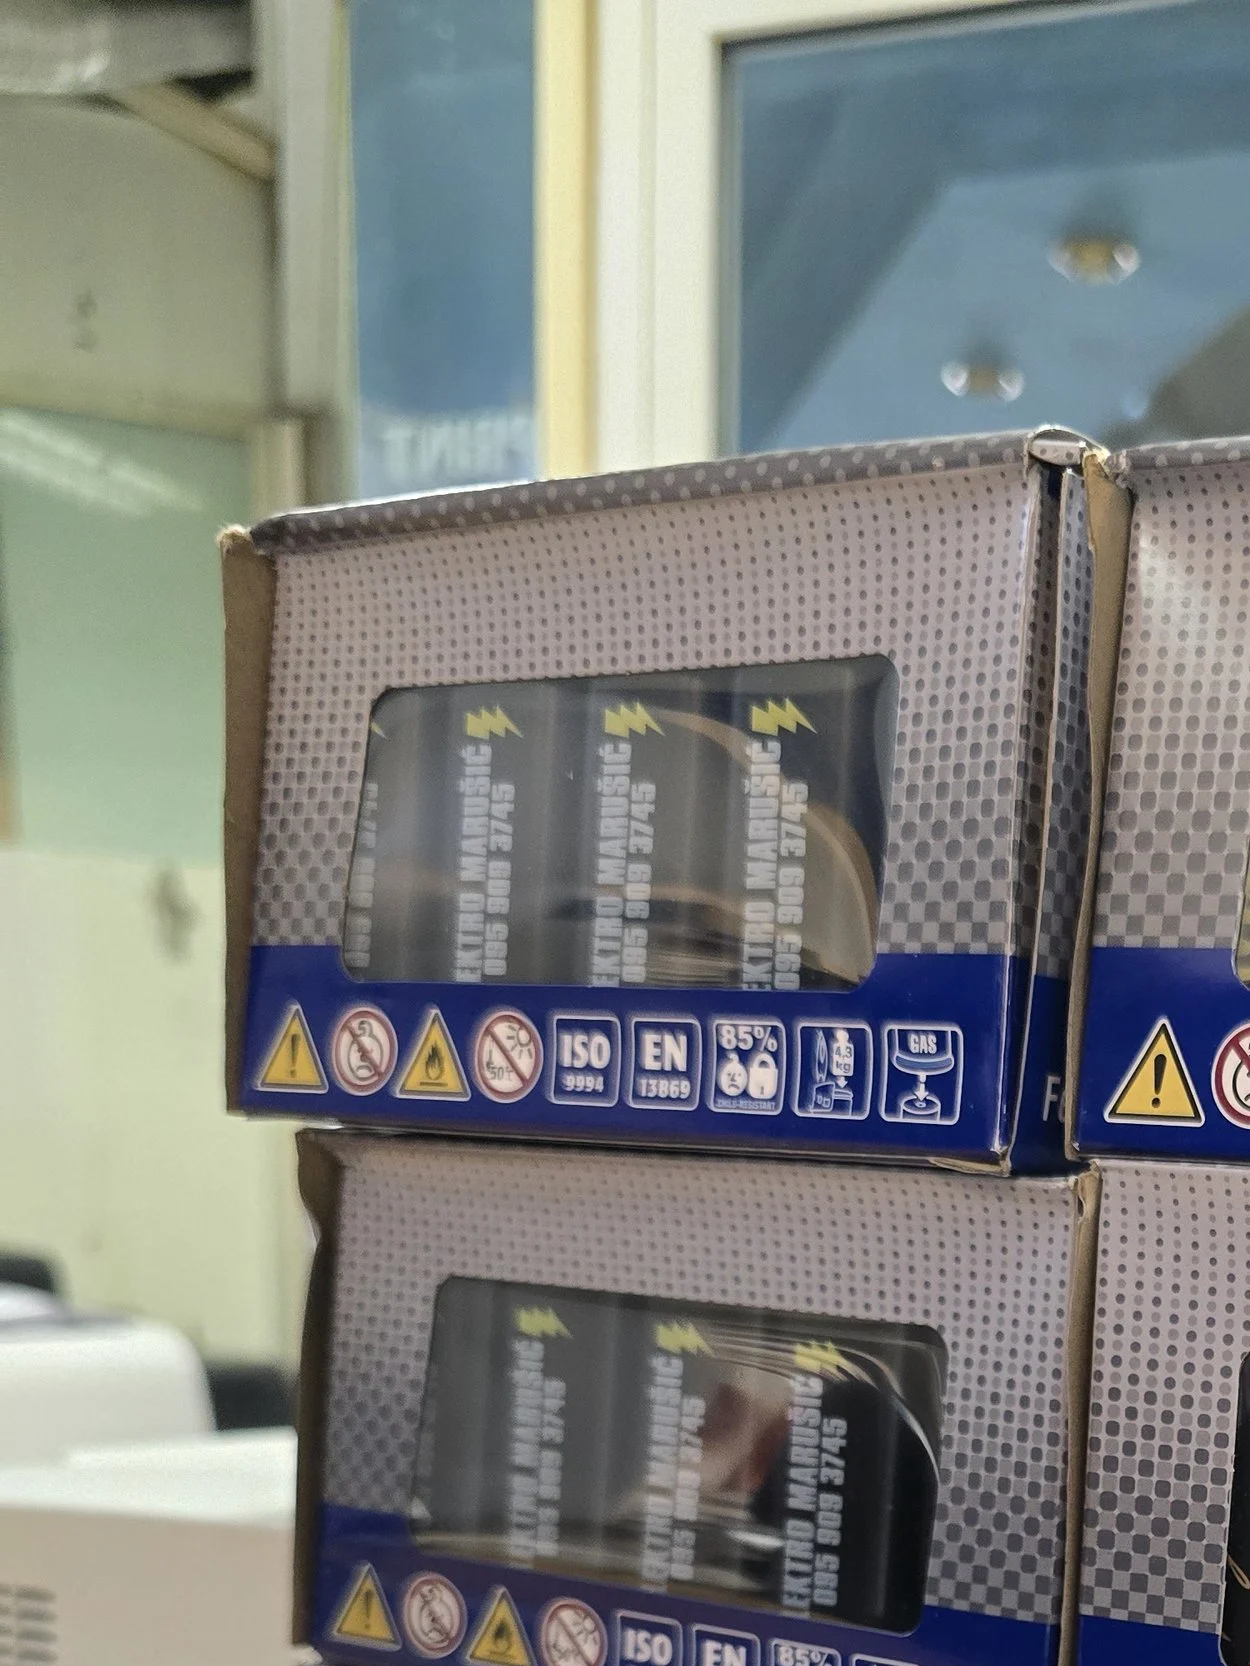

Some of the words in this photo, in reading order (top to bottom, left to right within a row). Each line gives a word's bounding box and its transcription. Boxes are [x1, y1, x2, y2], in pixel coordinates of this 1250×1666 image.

[629, 783, 656, 854] 3745
[745, 741, 781, 889] MARUŠIĆ
[780, 783, 808, 857] 3745
[777, 867, 805, 924] 909
[774, 934, 802, 990] 095
[561, 1033, 612, 1070] ISO
[643, 1033, 687, 1073] EN
[719, 1025, 778, 1053] 85%
[908, 1032, 938, 1055] GAS
[565, 1074, 605, 1094] 9994
[640, 1077, 691, 1101] 13869
[820, 1416, 848, 1486] 3745
